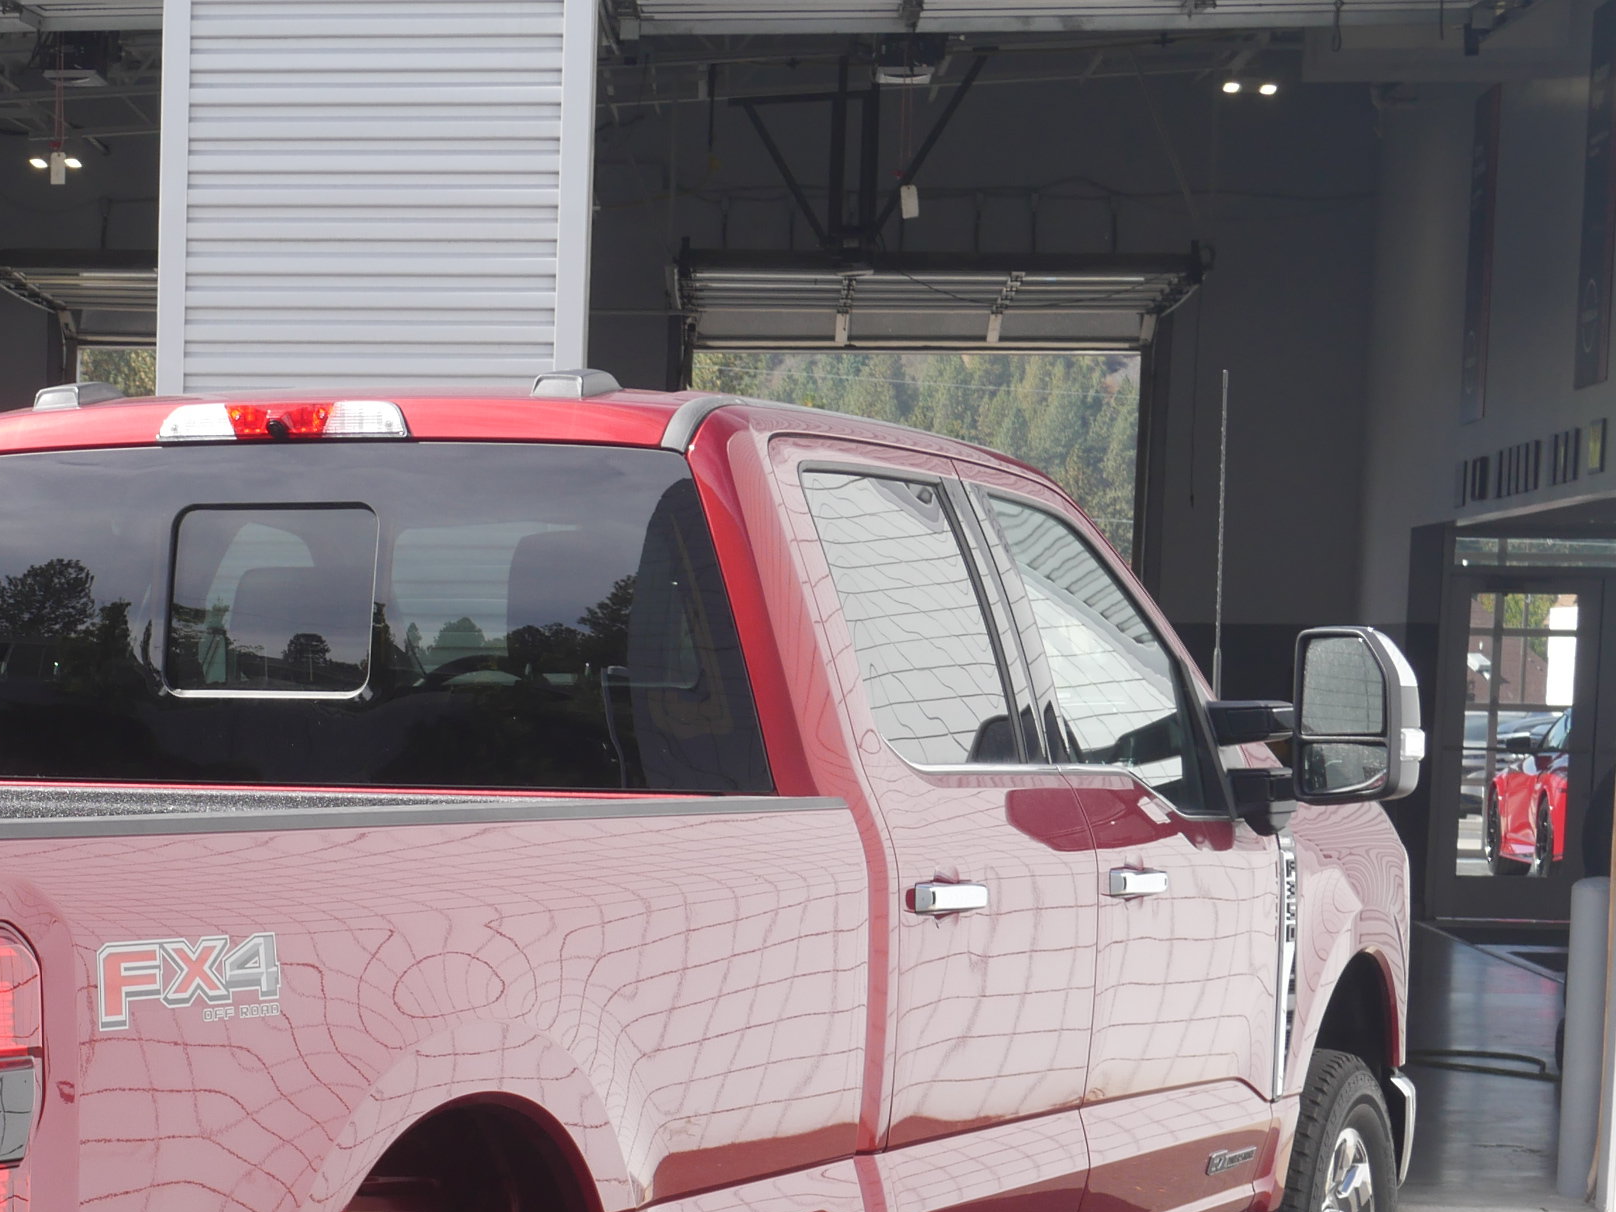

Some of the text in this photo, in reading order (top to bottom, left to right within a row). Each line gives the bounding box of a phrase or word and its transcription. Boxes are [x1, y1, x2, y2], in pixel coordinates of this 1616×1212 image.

[96, 932, 281, 1031] FX4
[202, 1003, 280, 1022] OFF ROAD
